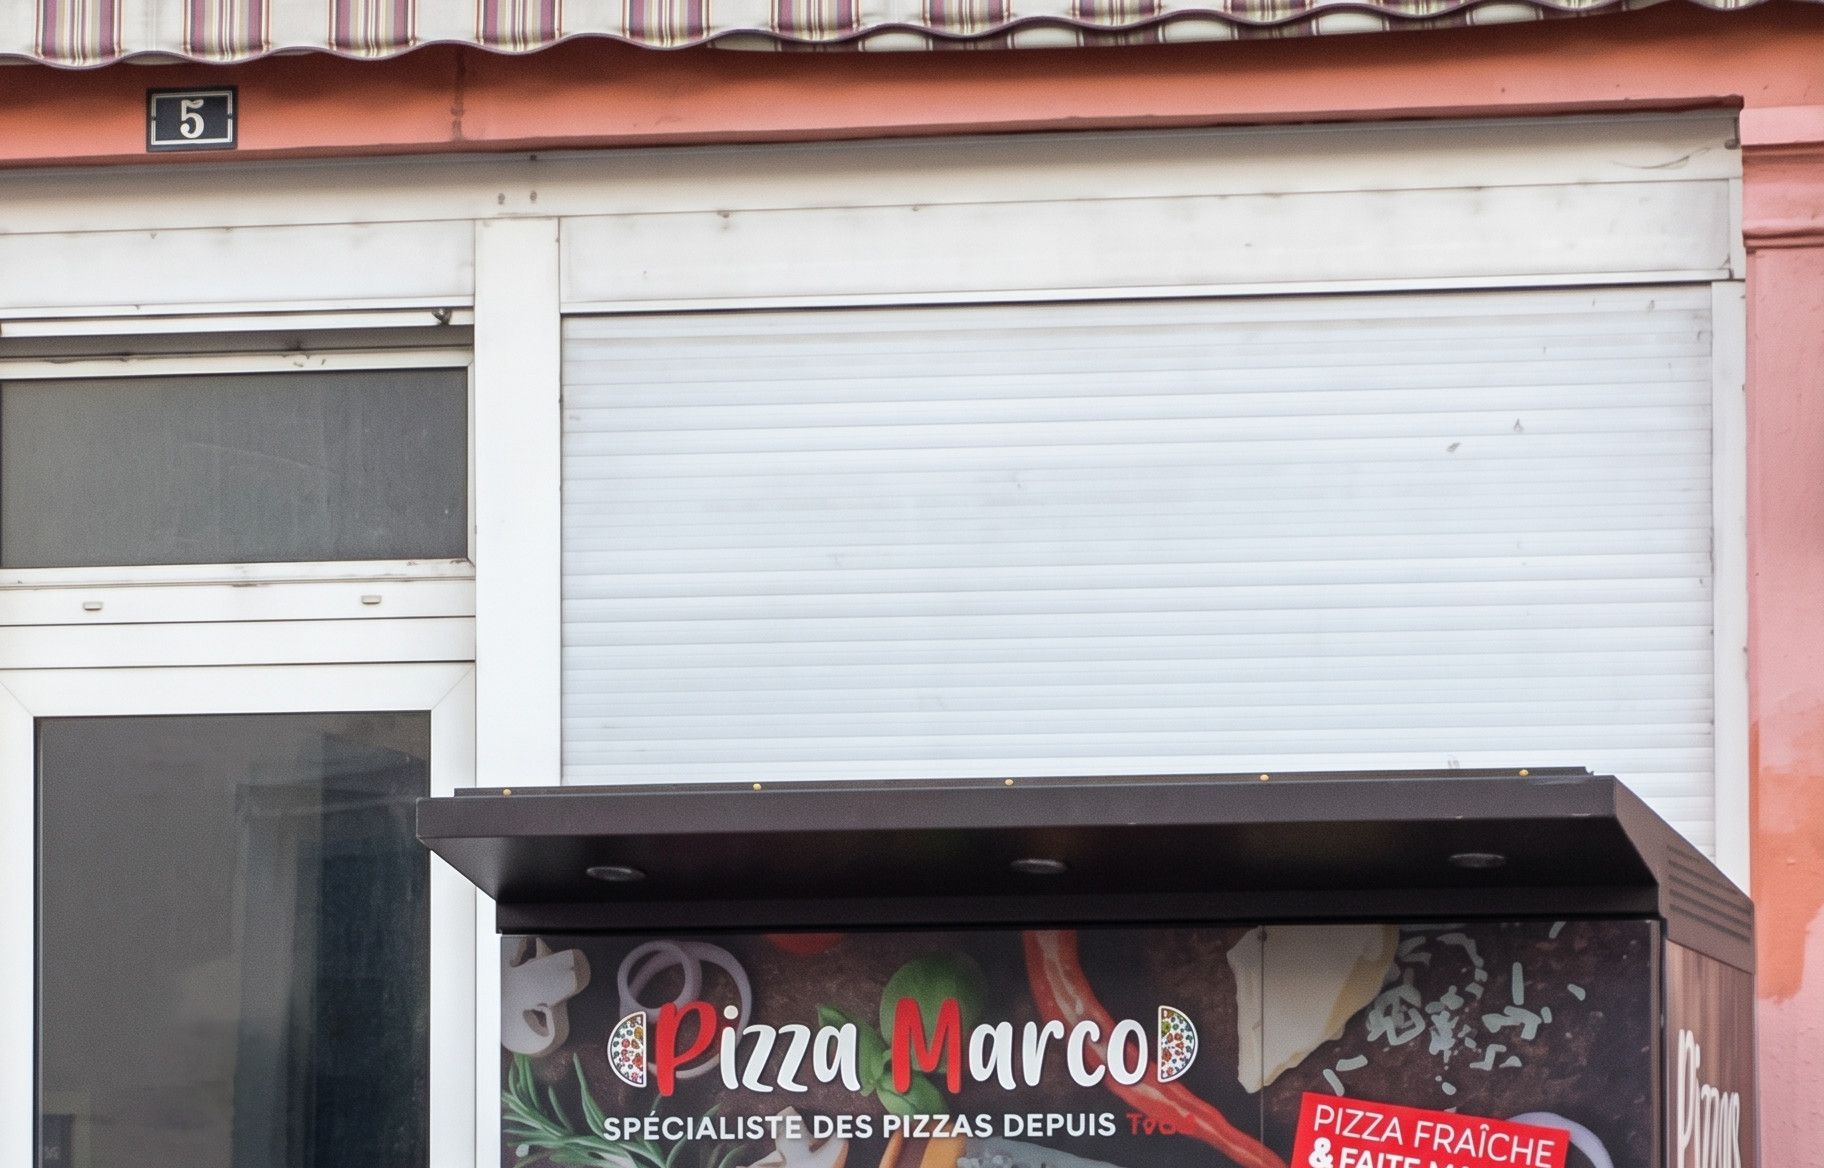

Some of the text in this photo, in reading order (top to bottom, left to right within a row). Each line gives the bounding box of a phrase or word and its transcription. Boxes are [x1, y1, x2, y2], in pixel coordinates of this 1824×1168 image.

[180, 98, 205, 139] 5
[655, 998, 1149, 1096] Pizza Marco
[603, 1109, 803, 1141] SPÉCIALISTE
[813, 1115, 874, 1139] DES
[883, 1114, 993, 1138] PIZZAS
[1004, 1113, 1117, 1137] DEPUIS
[1313, 1104, 1556, 1168] PIZZA FRAÎCHE
